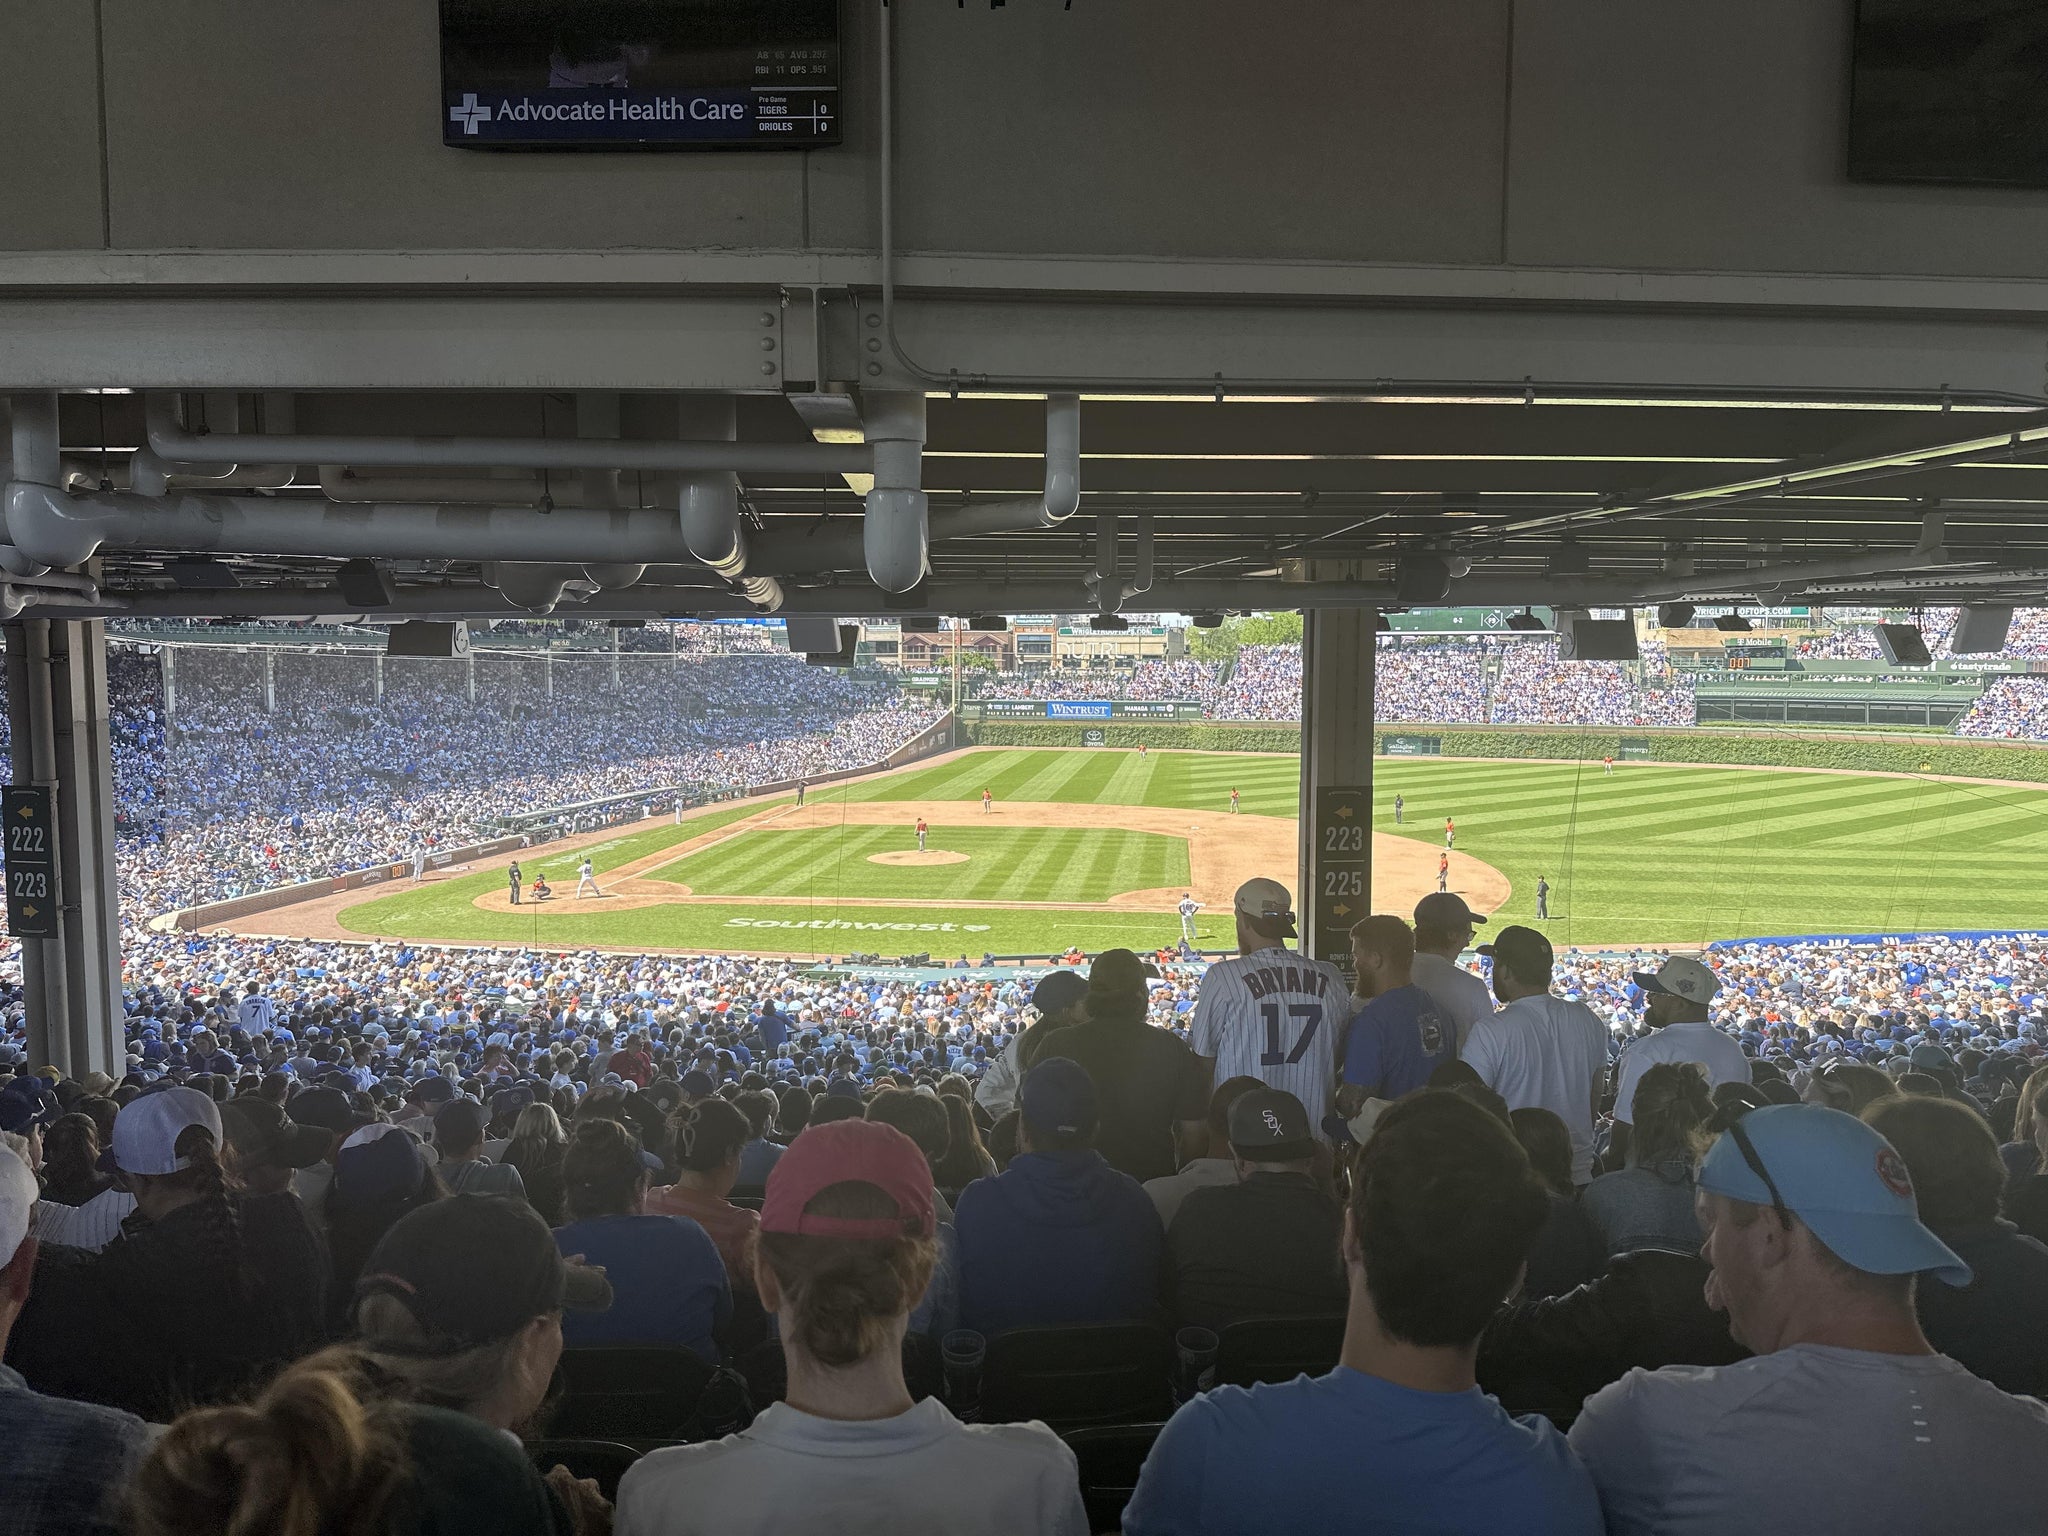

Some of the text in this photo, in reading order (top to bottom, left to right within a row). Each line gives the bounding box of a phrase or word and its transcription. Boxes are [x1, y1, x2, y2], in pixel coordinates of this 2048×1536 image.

[790, 51, 808, 59] AVG
[755, 66, 769, 74] RBI
[776, 66, 785, 74] 11
[790, 66, 807, 74] OPS
[496, 97, 605, 121] Advocate
[609, 97, 684, 121] Health
[758, 104, 827, 114] TIGERS 0
[759, 122, 828, 132] ORIOLES 0
[1958, 662, 2011, 672] tastytrade
[1052, 704, 1109, 715] WINTRUST
[12, 826, 45, 852] 222
[1325, 826, 1363, 852] 223
[14, 872, 47, 898] 223
[1325, 871, 1363, 897] 225
[722, 918, 960, 932] Southwest
[1242, 966, 1330, 1000] BRYANT
[251, 1005, 261, 1018] 7
[1261, 1003, 1323, 1066] 17
[1262, 1109, 1284, 1137] SOX
